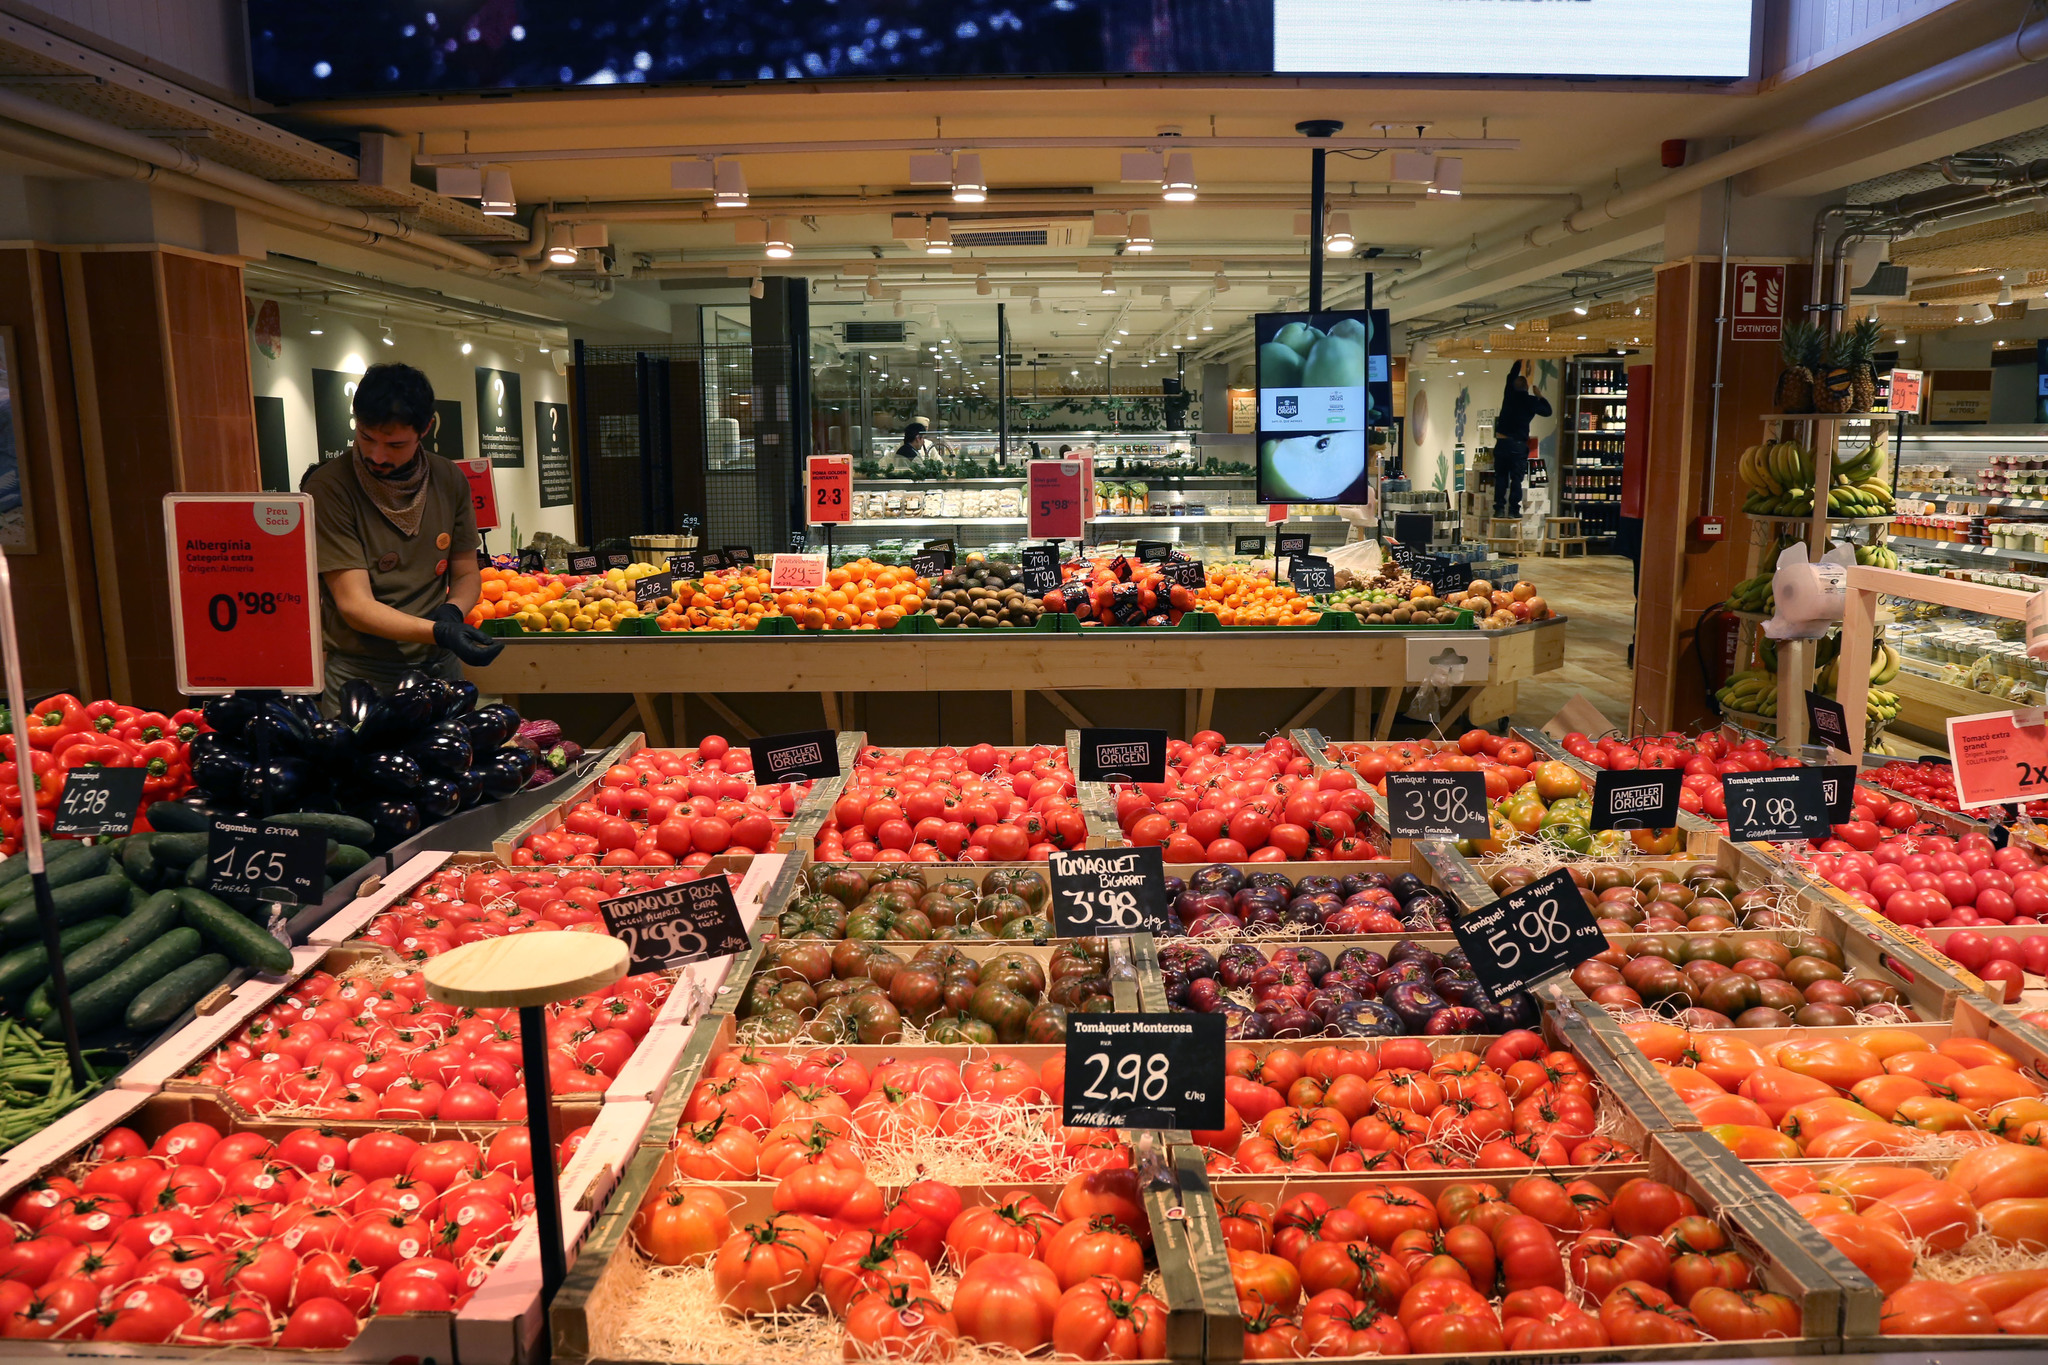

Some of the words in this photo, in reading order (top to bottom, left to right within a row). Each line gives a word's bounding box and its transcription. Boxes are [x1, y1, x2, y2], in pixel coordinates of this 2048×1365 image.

[1736, 324, 1778, 334] EXTINTOR
[266, 507, 288, 516] Preu
[265, 517, 290, 526] Socis
[186, 539, 252, 553] Albergínia
[186, 553, 229, 563] Categoria
[231, 554, 254, 562] extra
[187, 564, 218, 574] Origen:
[1962, 734, 1991, 743] Tomacó
[1991, 731, 2011, 740] extra
[772, 745, 815, 761] AMETLLER
[1101, 745, 1145, 755] AMETLLER
[1963, 742, 1988, 752] granel
[774, 752, 819, 768] ORIGEN
[1101, 752, 1146, 765] ORIGEN
[1390, 774, 1427, 786] Tomàquet
[1432, 777, 1456, 785] morat
[1727, 776, 1764, 785] Tomàquet
[1764, 774, 1800, 783] marmade
[1614, 787, 1659, 800] AMETLLER
[64, 788, 110, 815] 4,98
[1405, 786, 1469, 824] 3'98
[1468, 811, 1486, 823] €/kg
[1614, 794, 1660, 810] ORIGEN
[101, 824, 129, 832] EXTRA
[215, 821, 258, 834] Cogombre
[264, 826, 300, 837] EXTRA
[1424, 825, 1453, 834] Granada
[213, 846, 287, 881] 1,65
[295, 877, 311, 887] €/kg
[689, 882, 723, 901] ROSA
[1061, 889, 1143, 929] 3'98
[1460, 907, 1506, 935] Tomàquet
[616, 918, 708, 963] 2'98
[1487, 899, 1571, 969] 5'98
[1074, 1022, 1131, 1035] Tomàquet
[1132, 1022, 1193, 1033] Monterosa
[1083, 1052, 1170, 1102] 2,98
[1184, 1091, 1206, 1102] €/kg
